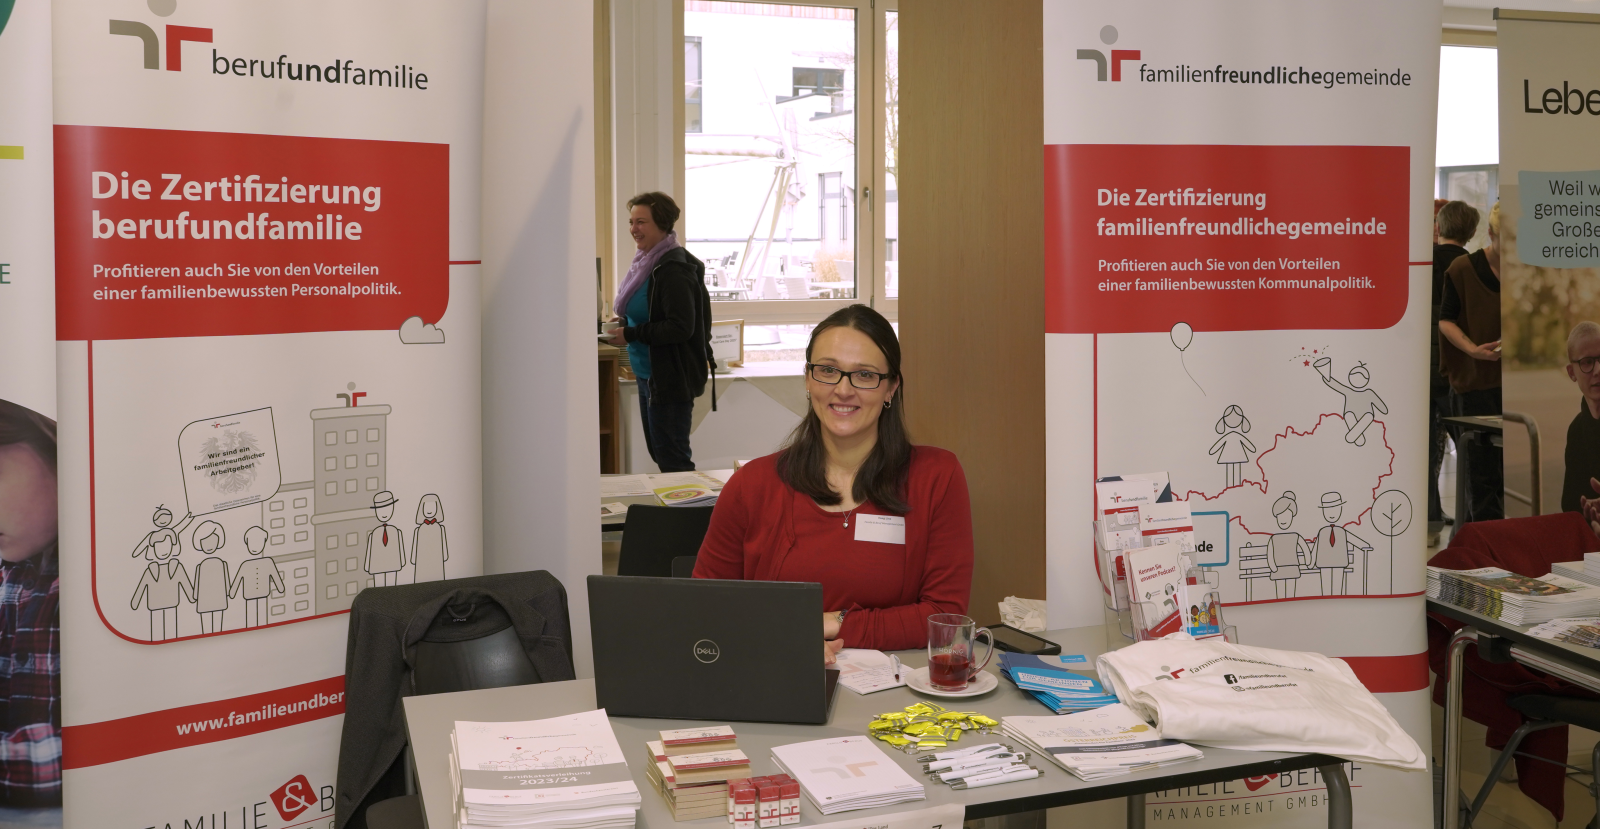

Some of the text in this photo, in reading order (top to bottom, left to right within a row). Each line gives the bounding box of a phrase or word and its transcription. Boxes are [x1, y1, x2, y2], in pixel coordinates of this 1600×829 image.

[212, 49, 429, 90] berufundfamilie
[1139, 64, 1412, 89] familienfreundlichegemeinde
[91, 171, 382, 212] Die Zertifizierung
[1549, 180, 1583, 196] Weil
[1097, 187, 1267, 211] Die Zertifizierung
[92, 210, 363, 241] berufundfamilie
[1096, 217, 1387, 240] familienfreundlichegemeinde
[93, 263, 380, 279] Profitieren auch Sie von den Vorteilen
[1098, 258, 1340, 272] Profitieren auch Sie von den Vorteilen
[92, 282, 402, 301] einer familienbewussten Personalpolitik.
[1098, 276, 1376, 292] einer familienbewussten Kommunalpolitik.
[194, 452, 265, 470] familienfreundlicher
[222, 449, 237, 457] sind
[1138, 563, 1162, 576] Kennen Sie
[1140, 565, 1176, 583] unseren Podcast?
[696, 647, 718, 655] DELL
[176, 691, 345, 735] www.familieundber
[503, 770, 592, 780] Zertifikatsverleihung
[519, 776, 579, 786] 2023/24
[1153, 800, 1274, 821] MANAGEMENT
